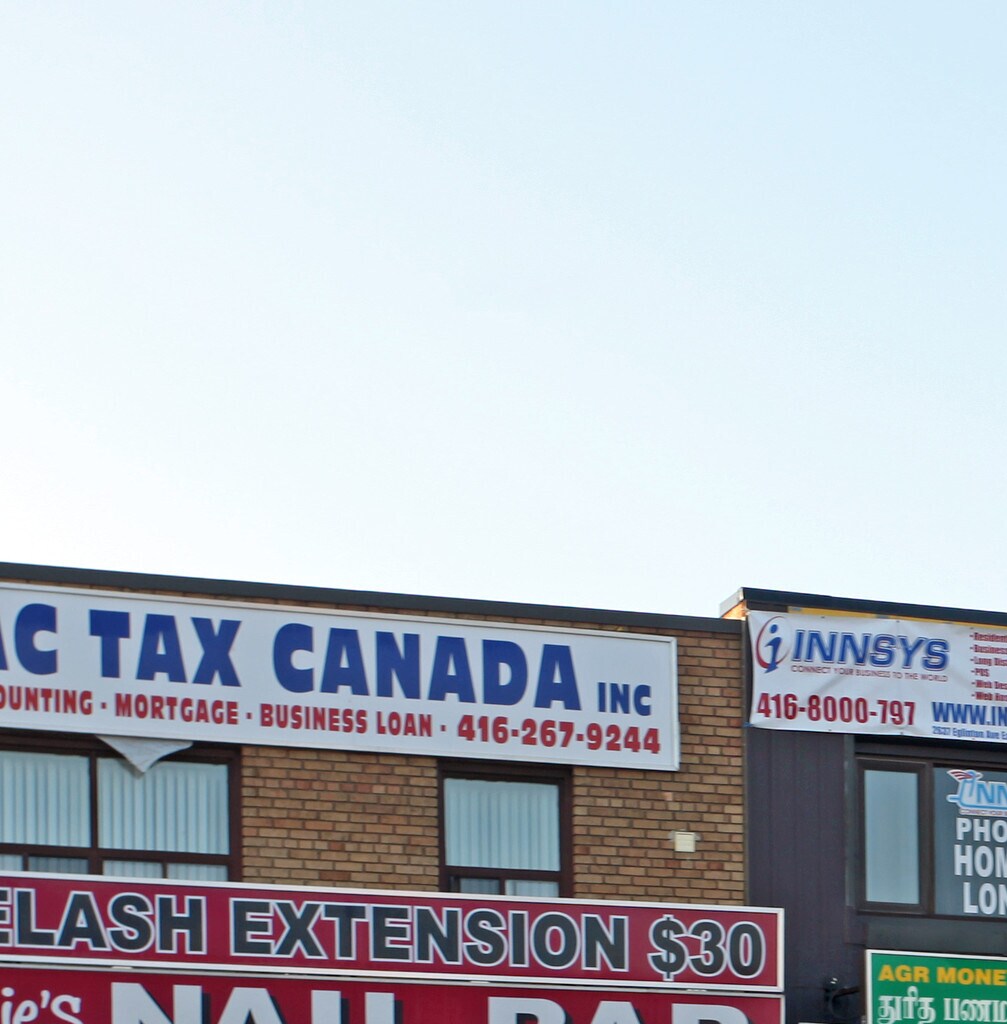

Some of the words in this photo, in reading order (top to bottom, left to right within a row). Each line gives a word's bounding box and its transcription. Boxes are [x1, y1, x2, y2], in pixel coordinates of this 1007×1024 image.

[0, 603, 57, 675] C
[88, 609, 242, 687] TAX
[272, 623, 581, 711] CANADA
[598, 682, 652, 716] INC
[791, 629, 950, 671] INNSYS
[115, 693, 239, 725] MORTGAGE
[260, 703, 368, 734] BUSINESS
[377, 711, 432, 737] LOAN
[458, 714, 661, 754] 416-267-9244
[757, 692, 916, 726] 416-8000-797
[229, 897, 629, 972] EXTENSION
[646, 914, 766, 981] $30
[878, 964, 930, 983] AGR
